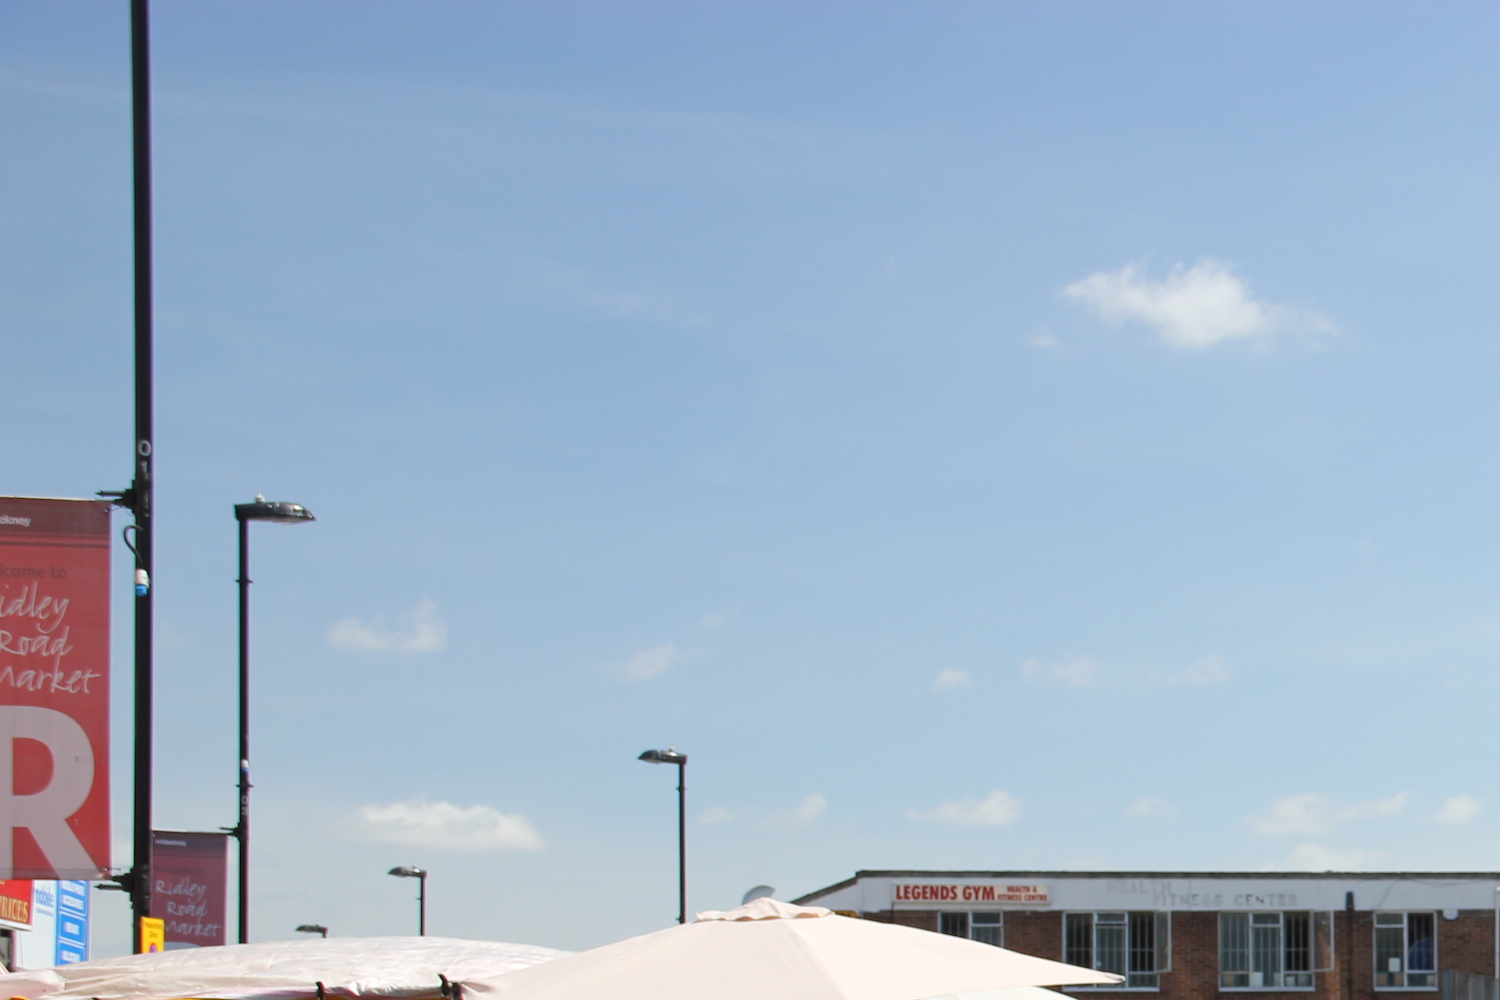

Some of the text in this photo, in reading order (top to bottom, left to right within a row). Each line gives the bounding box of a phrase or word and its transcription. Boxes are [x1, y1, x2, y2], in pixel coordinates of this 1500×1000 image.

[156, 876, 208, 904] Ridley
[895, 885, 996, 901] LEGENDS GYM
[167, 900, 209, 918] Road
